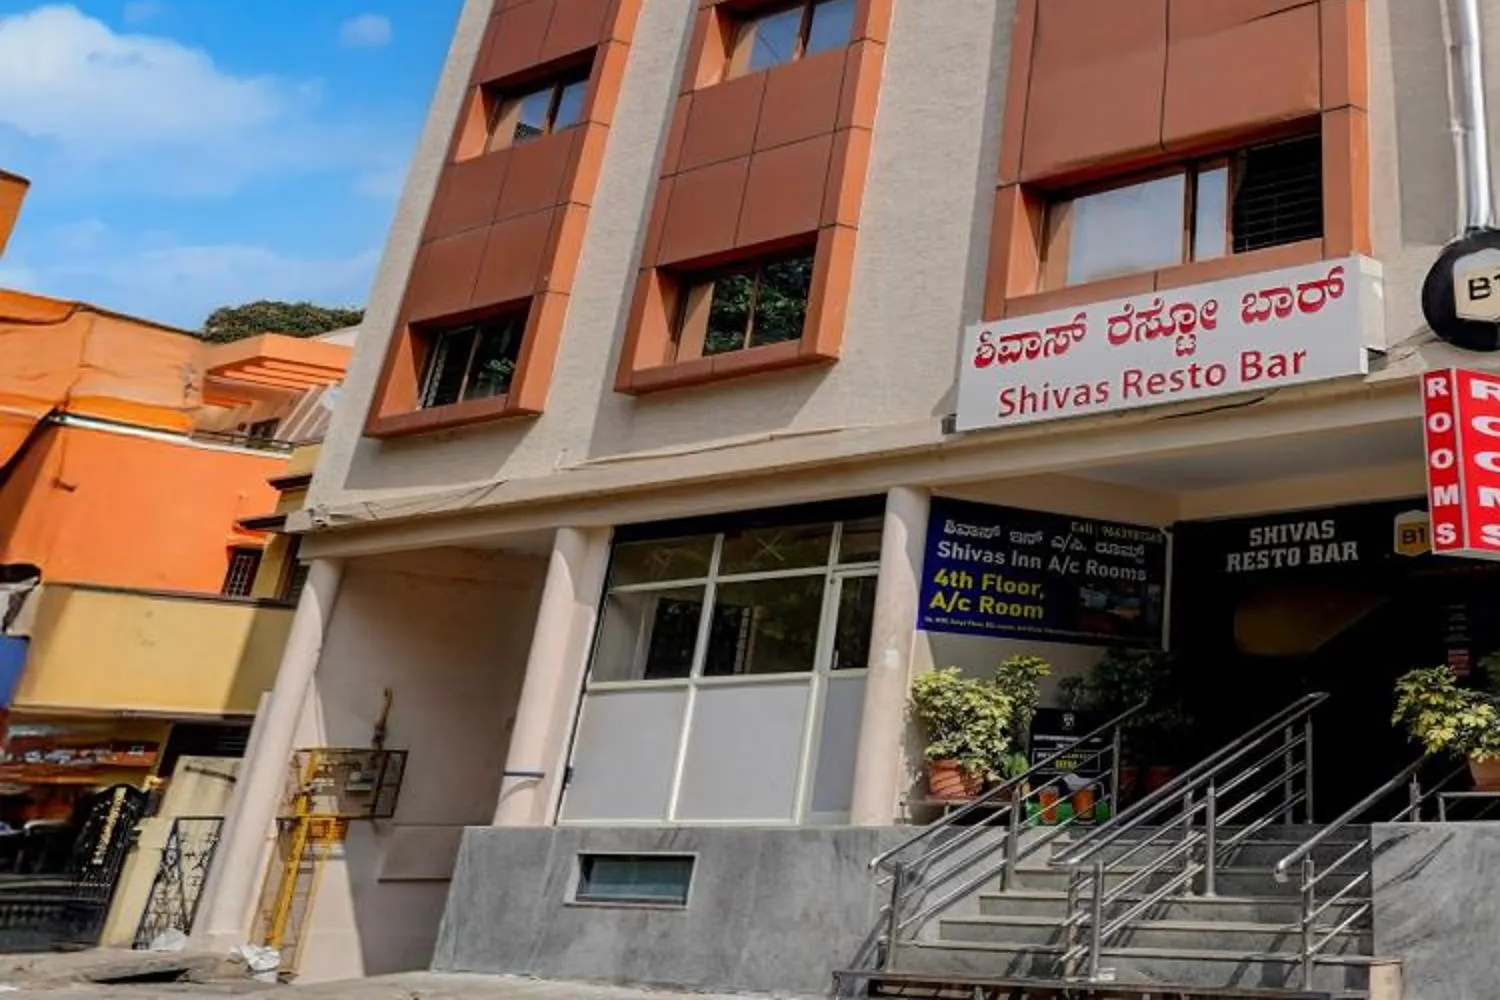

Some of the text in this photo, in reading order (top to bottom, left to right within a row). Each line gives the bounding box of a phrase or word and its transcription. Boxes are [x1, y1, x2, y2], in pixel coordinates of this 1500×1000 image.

[973, 312, 1087, 369] ಶಿವಾಸ್
[1241, 266, 1345, 325] ಬಾರ್
[998, 347, 1307, 418] Shivas Resto Bar
[1427, 377, 1460, 545] ROOMS
[1249, 519, 1335, 547] SHIVAS
[1401, 526, 1426, 545] B1
[936, 540, 1147, 581] Shivas Inn A/c Rooms
[1225, 541, 1358, 573] RESTO BAR
[933, 567, 1045, 599] 4th Floor,
[928, 591, 1044, 619] A/c Room
